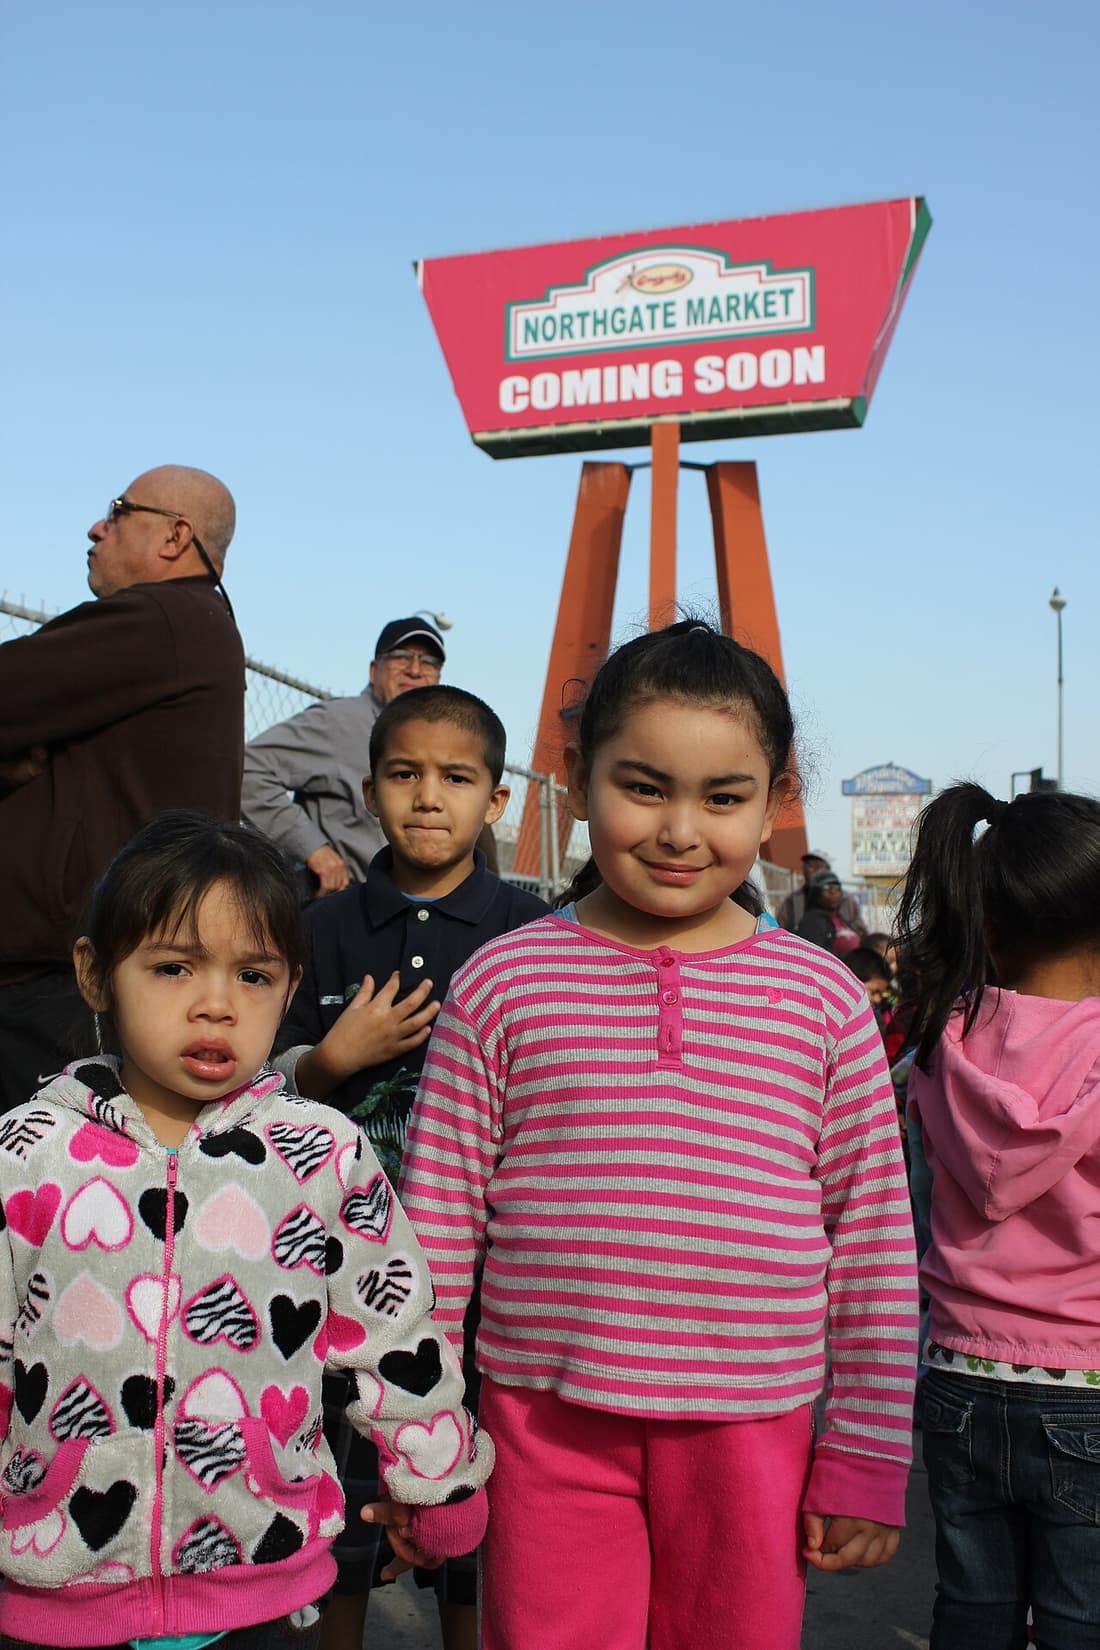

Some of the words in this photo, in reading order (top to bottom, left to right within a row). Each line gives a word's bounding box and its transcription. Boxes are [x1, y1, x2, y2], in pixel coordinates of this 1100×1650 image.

[522, 302, 676, 344] NORTHGATE
[686, 288, 795, 327] MARKET
[499, 360, 683, 413] COMING
[694, 346, 825, 393] SOON
